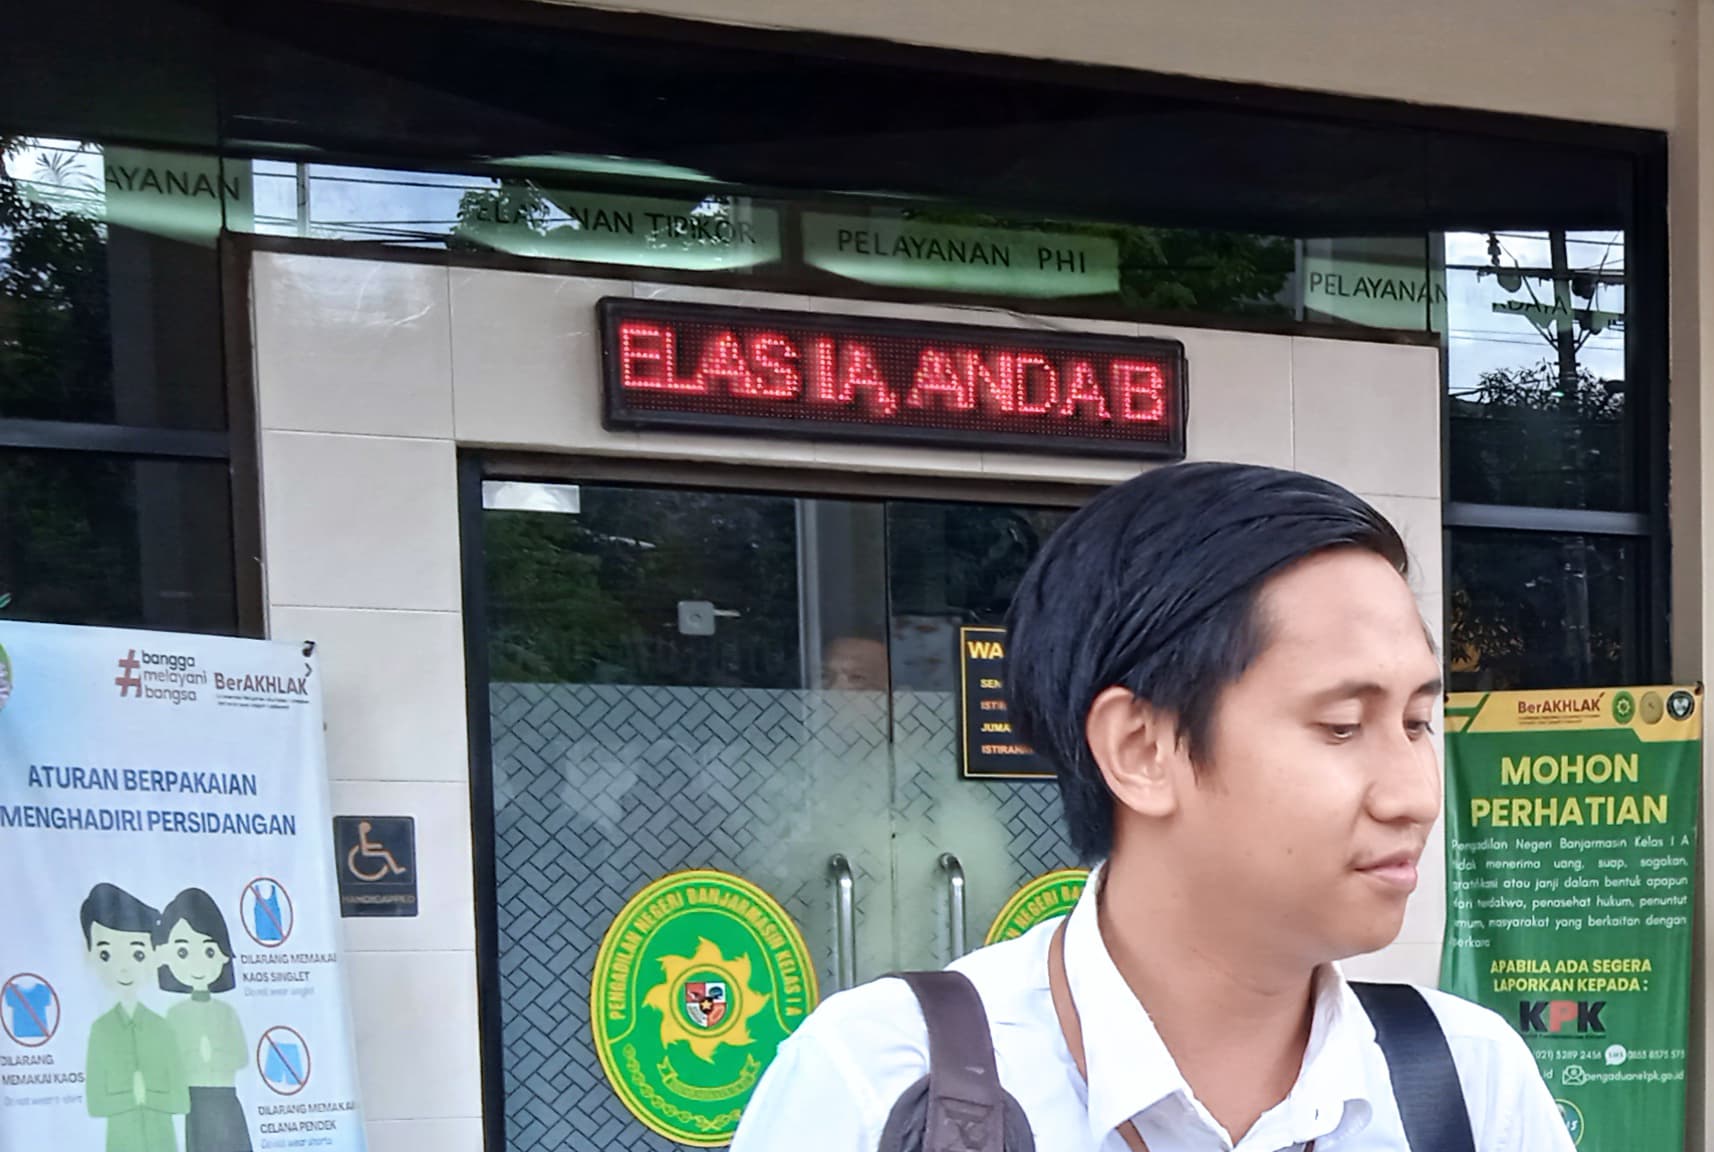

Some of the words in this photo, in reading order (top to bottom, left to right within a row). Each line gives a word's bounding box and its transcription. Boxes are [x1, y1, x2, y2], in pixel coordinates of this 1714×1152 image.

[837, 229, 1010, 267] PELAYANAN
[1037, 247, 1086, 273] PHI
[141, 650, 196, 671] bangga
[143, 669, 208, 687] melayani
[214, 672, 309, 696] BerAKHLAK
[144, 685, 197, 705] bangsa
[1518, 696, 1603, 714] BerAKHLAK
[1501, 753, 1639, 786] MOHON
[28, 765, 119, 791] ATURAN
[124, 768, 257, 796] BERPAKAIAN
[1471, 794, 1668, 828] PERHATIAN
[0, 805, 143, 832] MENGHADIRI
[148, 810, 296, 836] PERSIDANGAN
[1451, 837, 1508, 853] Pengadilan
[1516, 838, 1552, 853] Negeri
[1559, 837, 1627, 852] Banjarmasin
[1635, 835, 1663, 848] Kelas
[1681, 834, 1689, 846] A
[1486, 860, 1540, 870] menerima
[1503, 878, 1531, 888] atau
[1534, 878, 1559, 892] janji
[1564, 876, 1599, 888] dalam
[1605, 874, 1641, 888] bentuk
[1646, 877, 1688, 889] apapun
[1532, 895, 1591, 911] penasehat
[1596, 895, 1634, 907] hukum,
[1640, 895, 1687, 908] penuntut
[1555, 918, 1583, 931] yang
[1588, 914, 1640, 927] berkaitan
[1645, 914, 1687, 929] dengan
[633, 890, 685, 933] NEGERI
[775, 950, 802, 994] KELAS
[240, 953, 289, 965] DILARANG
[1490, 959, 1551, 974] APABILA
[1555, 959, 1589, 973] ADA
[1592, 958, 1652, 973] SEGERA
[242, 971, 269, 982] KAOS
[271, 970, 310, 982] SINGLET
[1493, 978, 1574, 992] LAPORKAN
[1577, 978, 1641, 992] KEPADA
[1519, 1000, 1606, 1033] KPK
[53, 1072, 86, 1083] KAOS
[258, 1103, 307, 1116] DILARANG
[260, 1120, 298, 1134] CELANA
[299, 1119, 336, 1132] PENDEK
